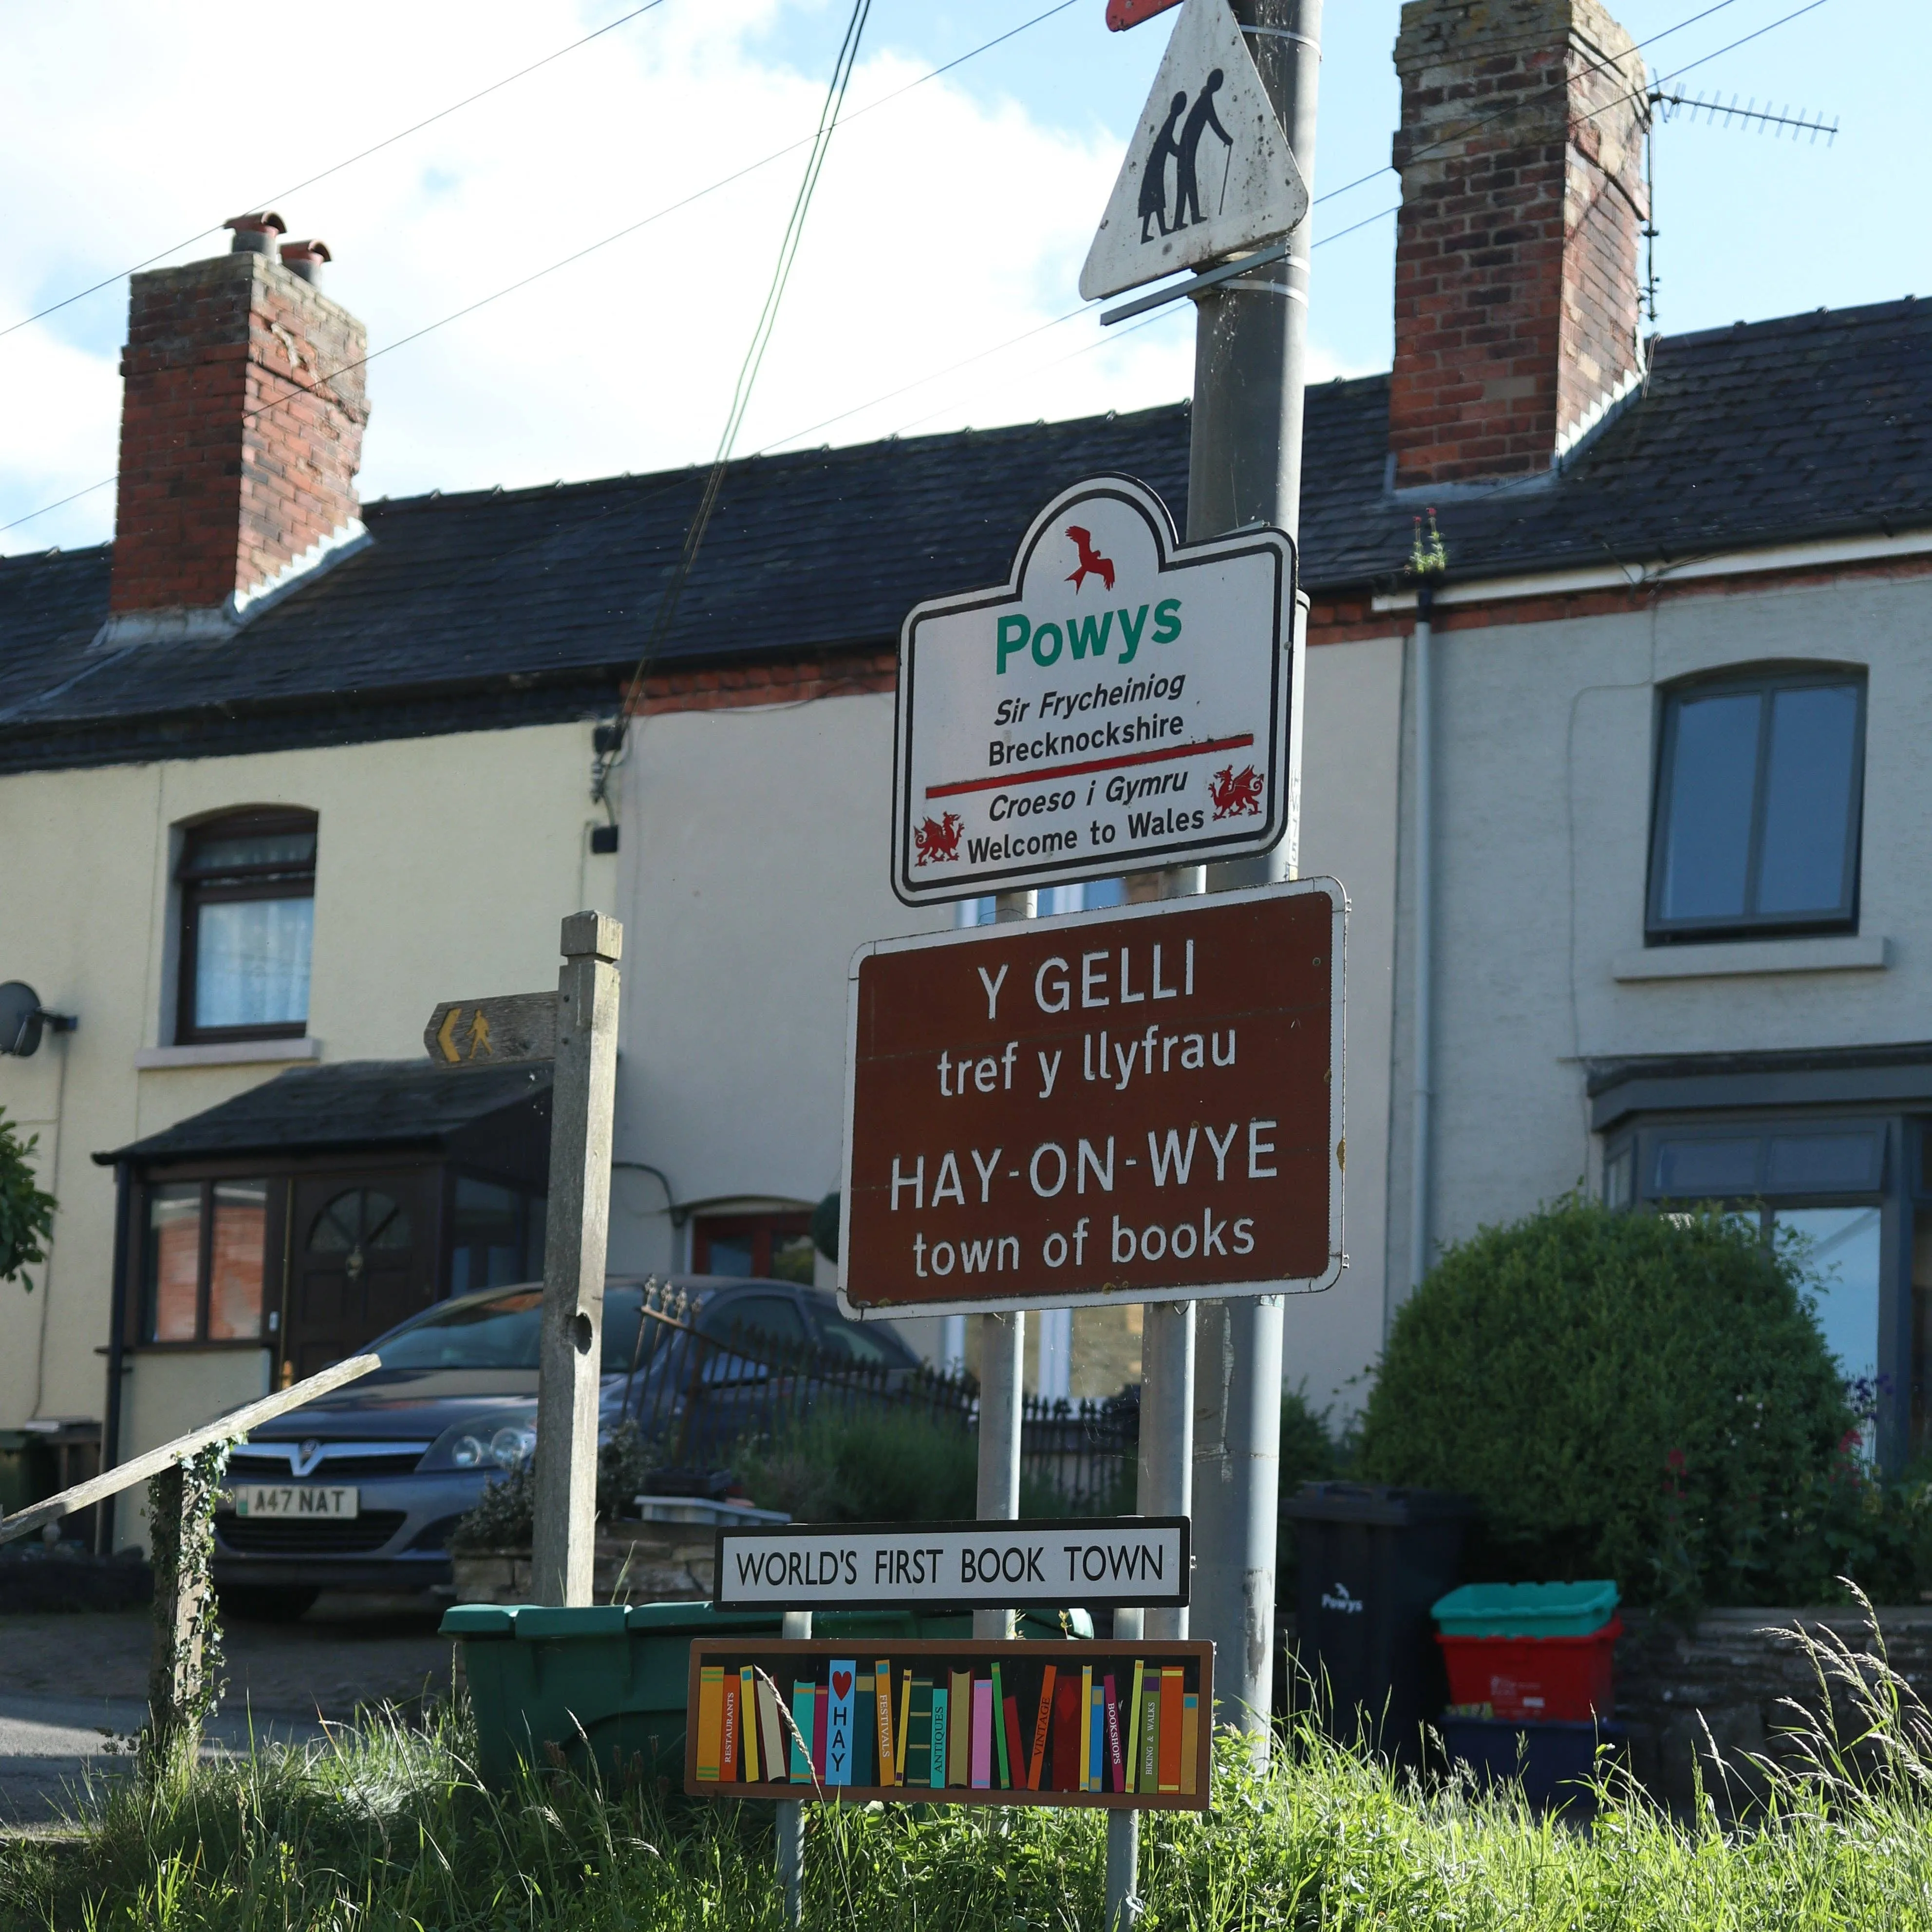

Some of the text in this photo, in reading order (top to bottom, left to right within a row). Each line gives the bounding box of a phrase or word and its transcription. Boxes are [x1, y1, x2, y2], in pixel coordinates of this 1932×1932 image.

[997, 599, 1181, 674] Powys
[994, 674, 1185, 726] Sir Frycheiniog
[990, 713, 1183, 766] Brecknockshire
[990, 771, 1188, 821] Croeso i Gymru
[968, 808, 1204, 863] Welcome to Wales
[978, 939, 1193, 1019] Y GELLI
[938, 1025, 1235, 1098] tref y llyfrau
[891, 1119, 1277, 1210] HAY-ON-WYE
[913, 1208, 1254, 1276] town of books
[255, 1490, 345, 1512] A47 NAT
[736, 1545, 1163, 1586] WORLD'S FIRST BOOK TOWN
[725, 1692, 733, 1763] RESTAURANTS
[831, 1707, 846, 1772] HAY
[880, 1695, 890, 1757] FESTIVALS
[935, 1707, 945, 1773] ANTIQUES
[1033, 1697, 1050, 1756] VINTAGE
[1108, 1703, 1122, 1764] BOOKSHOPS
